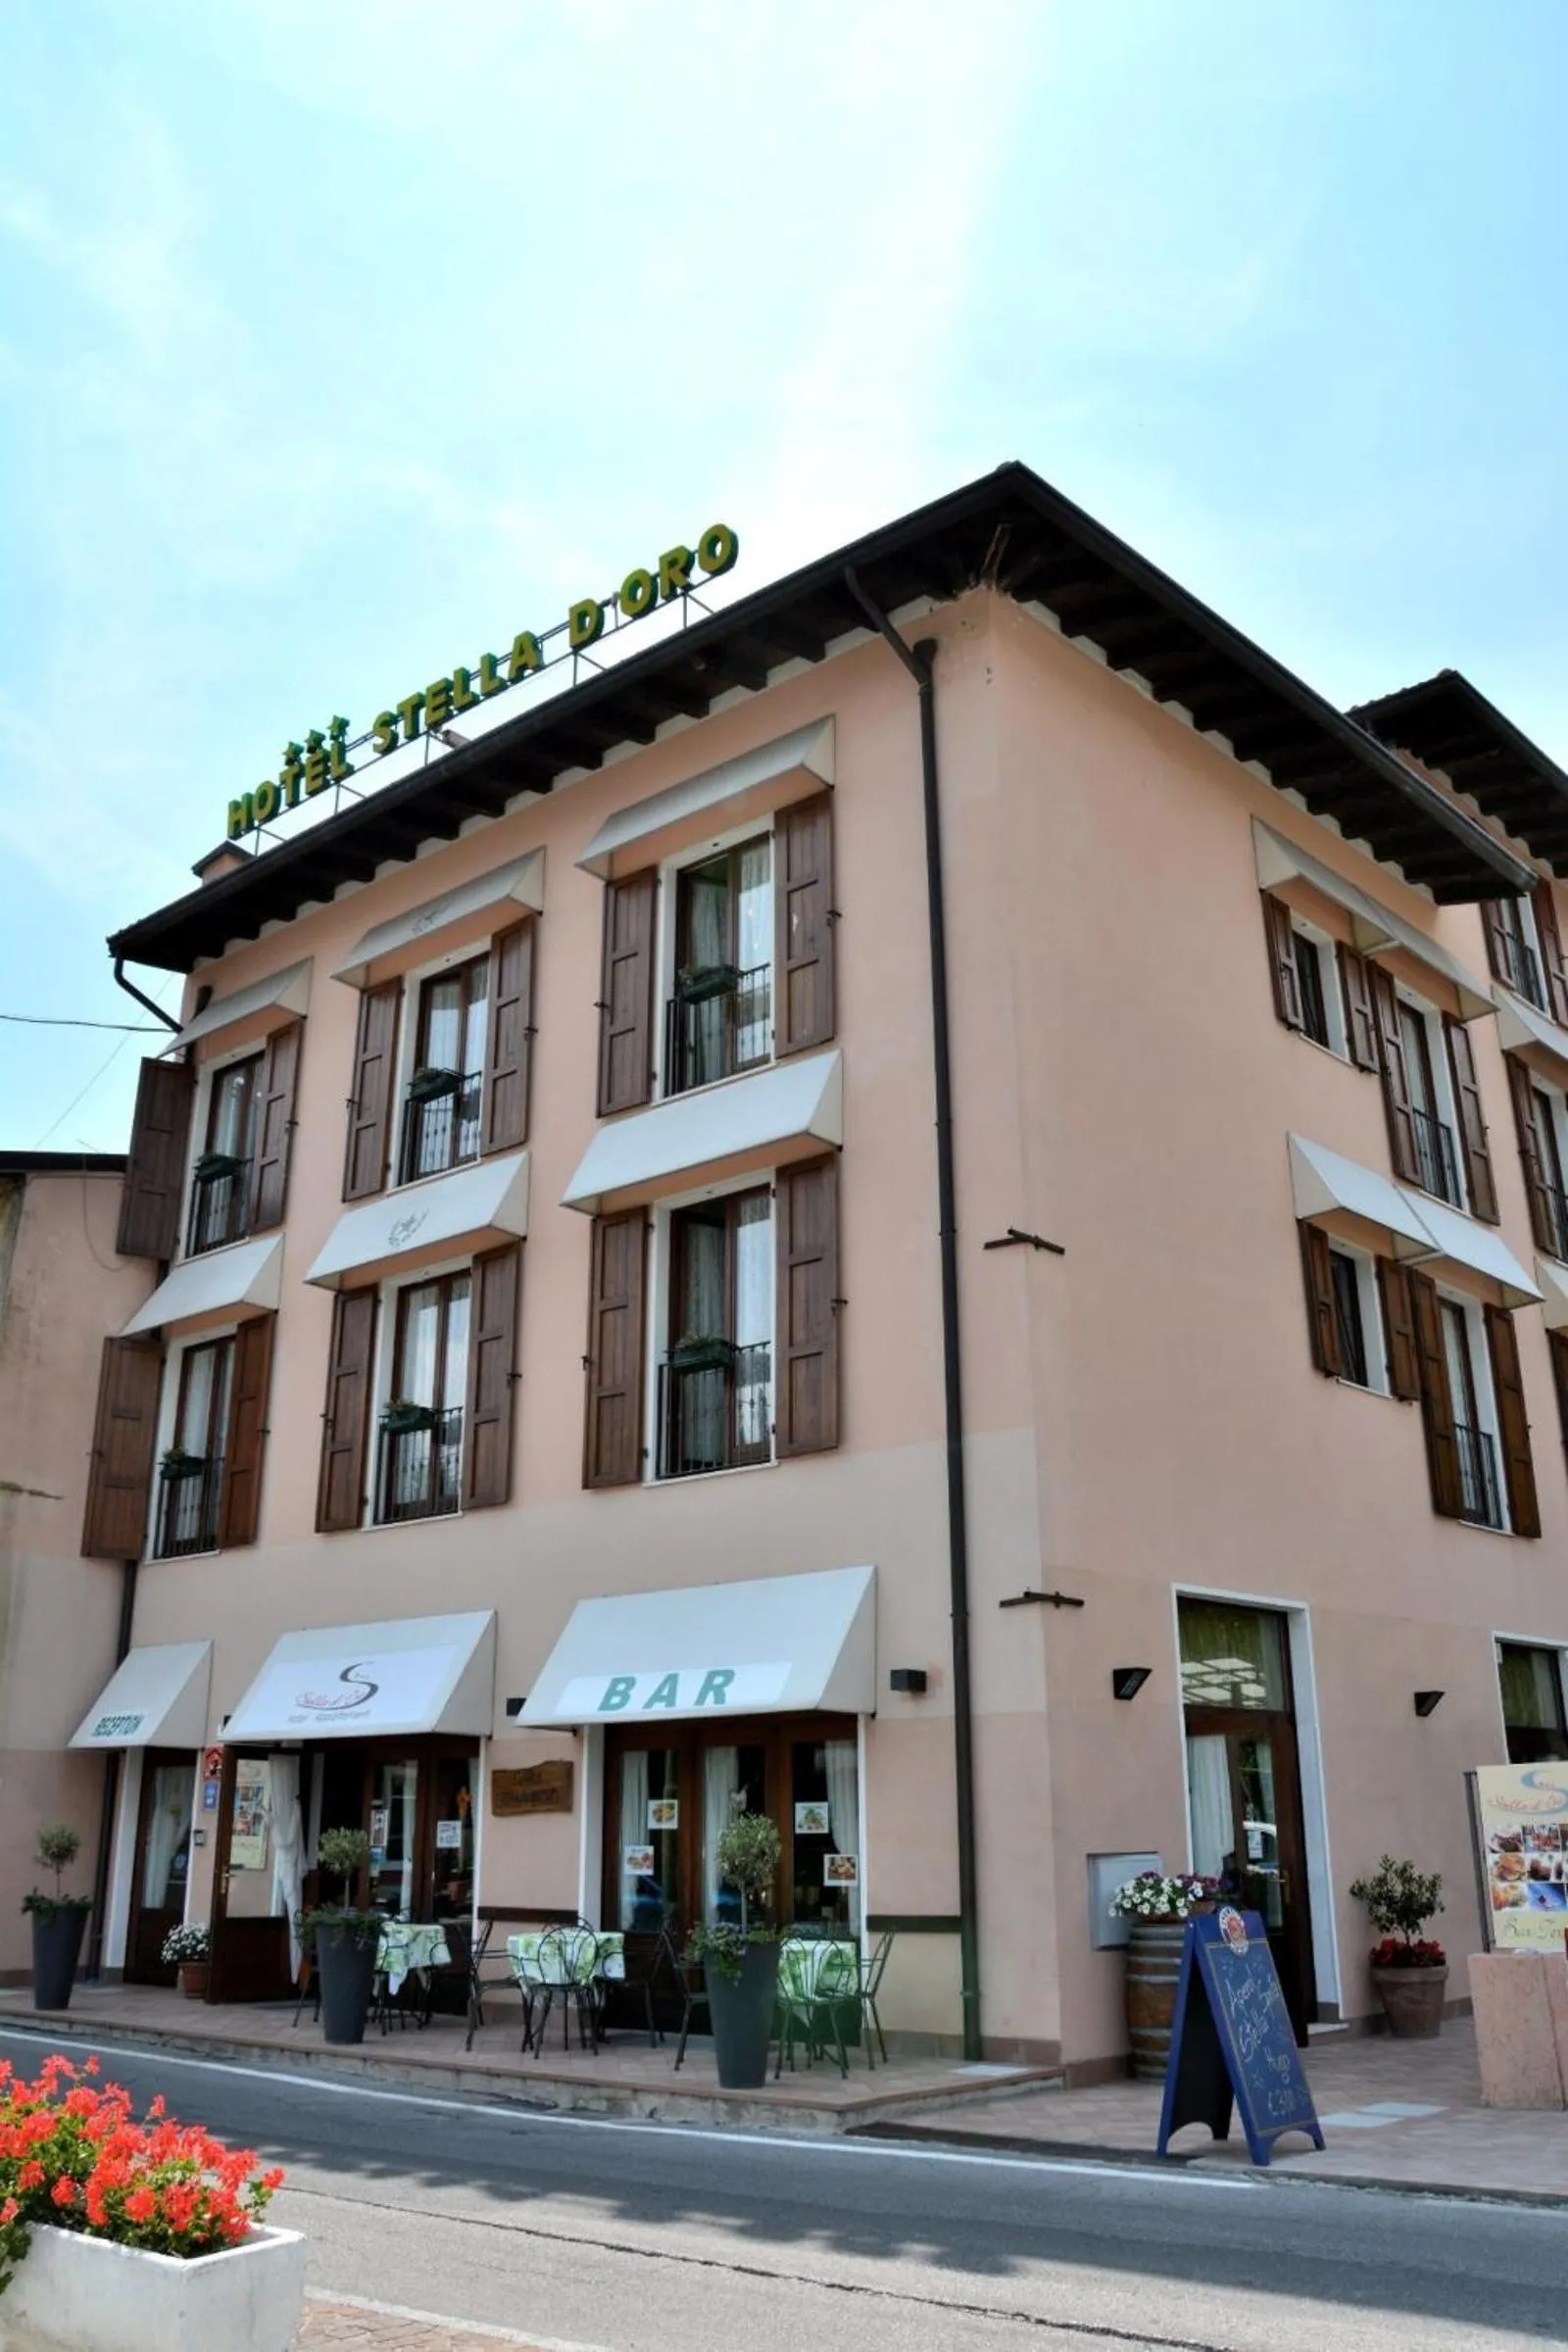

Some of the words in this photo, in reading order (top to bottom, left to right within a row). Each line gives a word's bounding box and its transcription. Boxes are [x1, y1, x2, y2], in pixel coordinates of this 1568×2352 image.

[227, 740, 355, 841] HOTEL
[372, 630, 545, 755] STELLA
[597, 1668, 735, 1712] BAR
